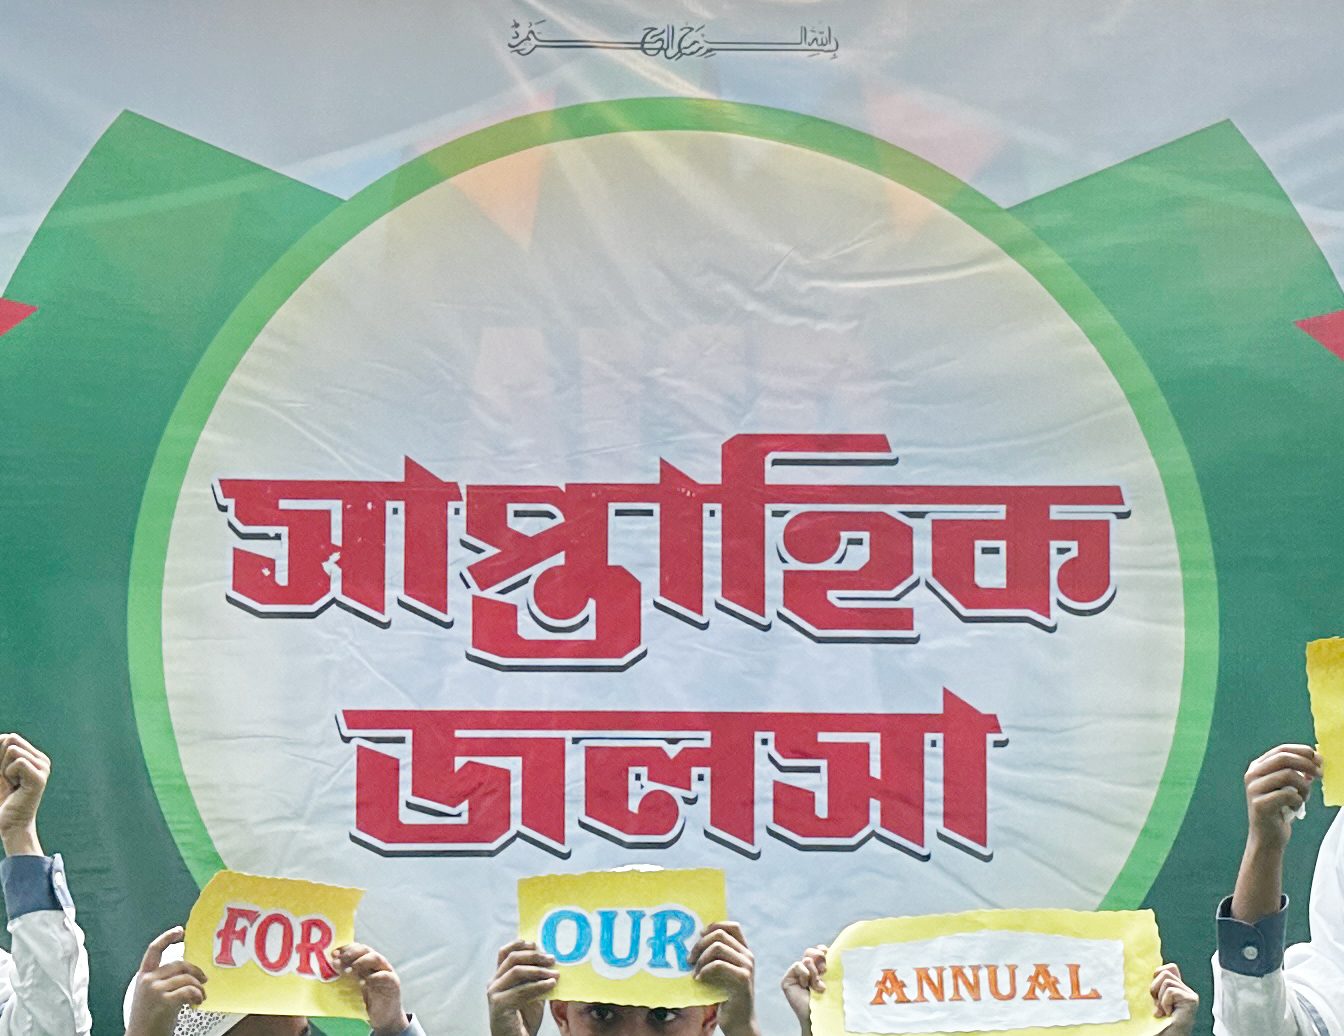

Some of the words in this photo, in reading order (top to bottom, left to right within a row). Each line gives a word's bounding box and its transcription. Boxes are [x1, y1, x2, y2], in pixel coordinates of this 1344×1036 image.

[212, 432, 1132, 672] সাপ্তাহিক
[335, 685, 1010, 859] জলসা
[213, 905, 344, 982] FOR
[553, 908, 697, 973] OUR
[868, 963, 1104, 1006] ANNUAL
